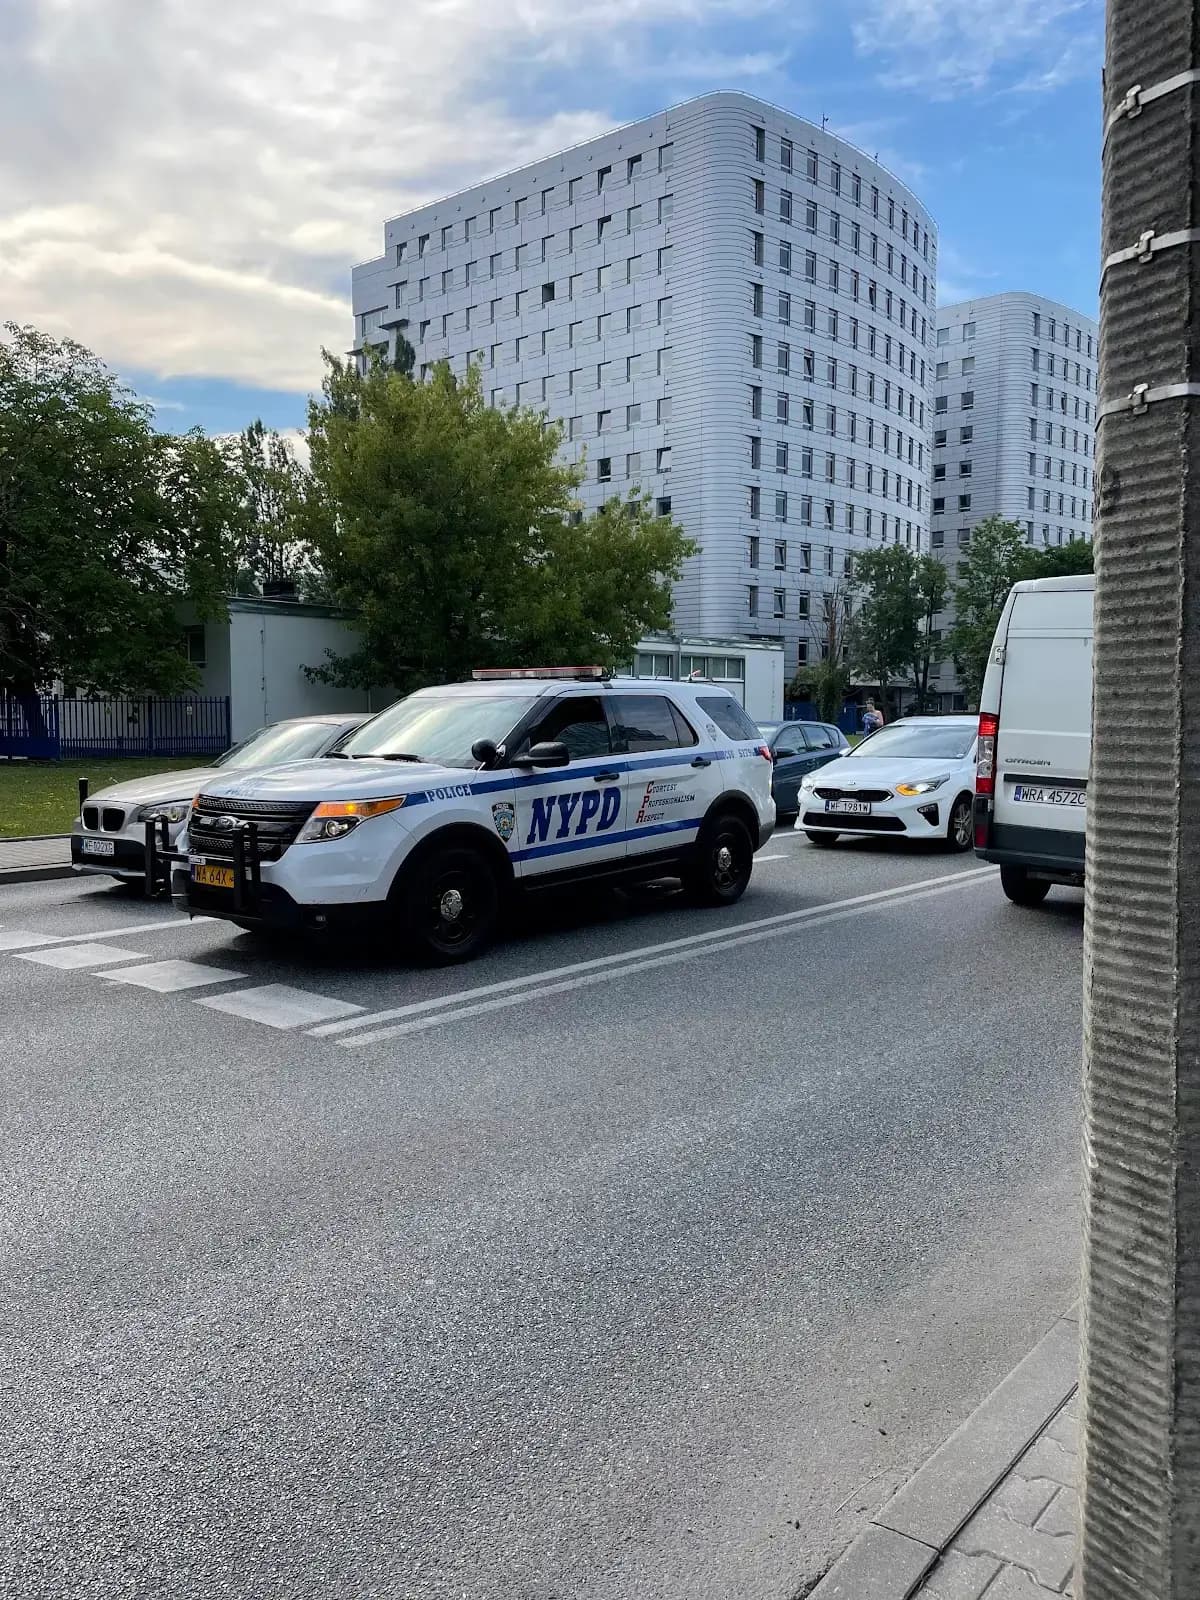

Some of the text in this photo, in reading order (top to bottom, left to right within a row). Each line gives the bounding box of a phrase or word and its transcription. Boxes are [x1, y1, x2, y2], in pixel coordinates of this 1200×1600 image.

[427, 784, 471, 802] POLICE
[641, 794, 695, 808] PROFESSIONALISM
[1021, 788, 1087, 804] WRA 4572C
[526, 787, 621, 844] NYPD
[636, 810, 665, 823] RESPECT
[210, 868, 227, 885] 64X
